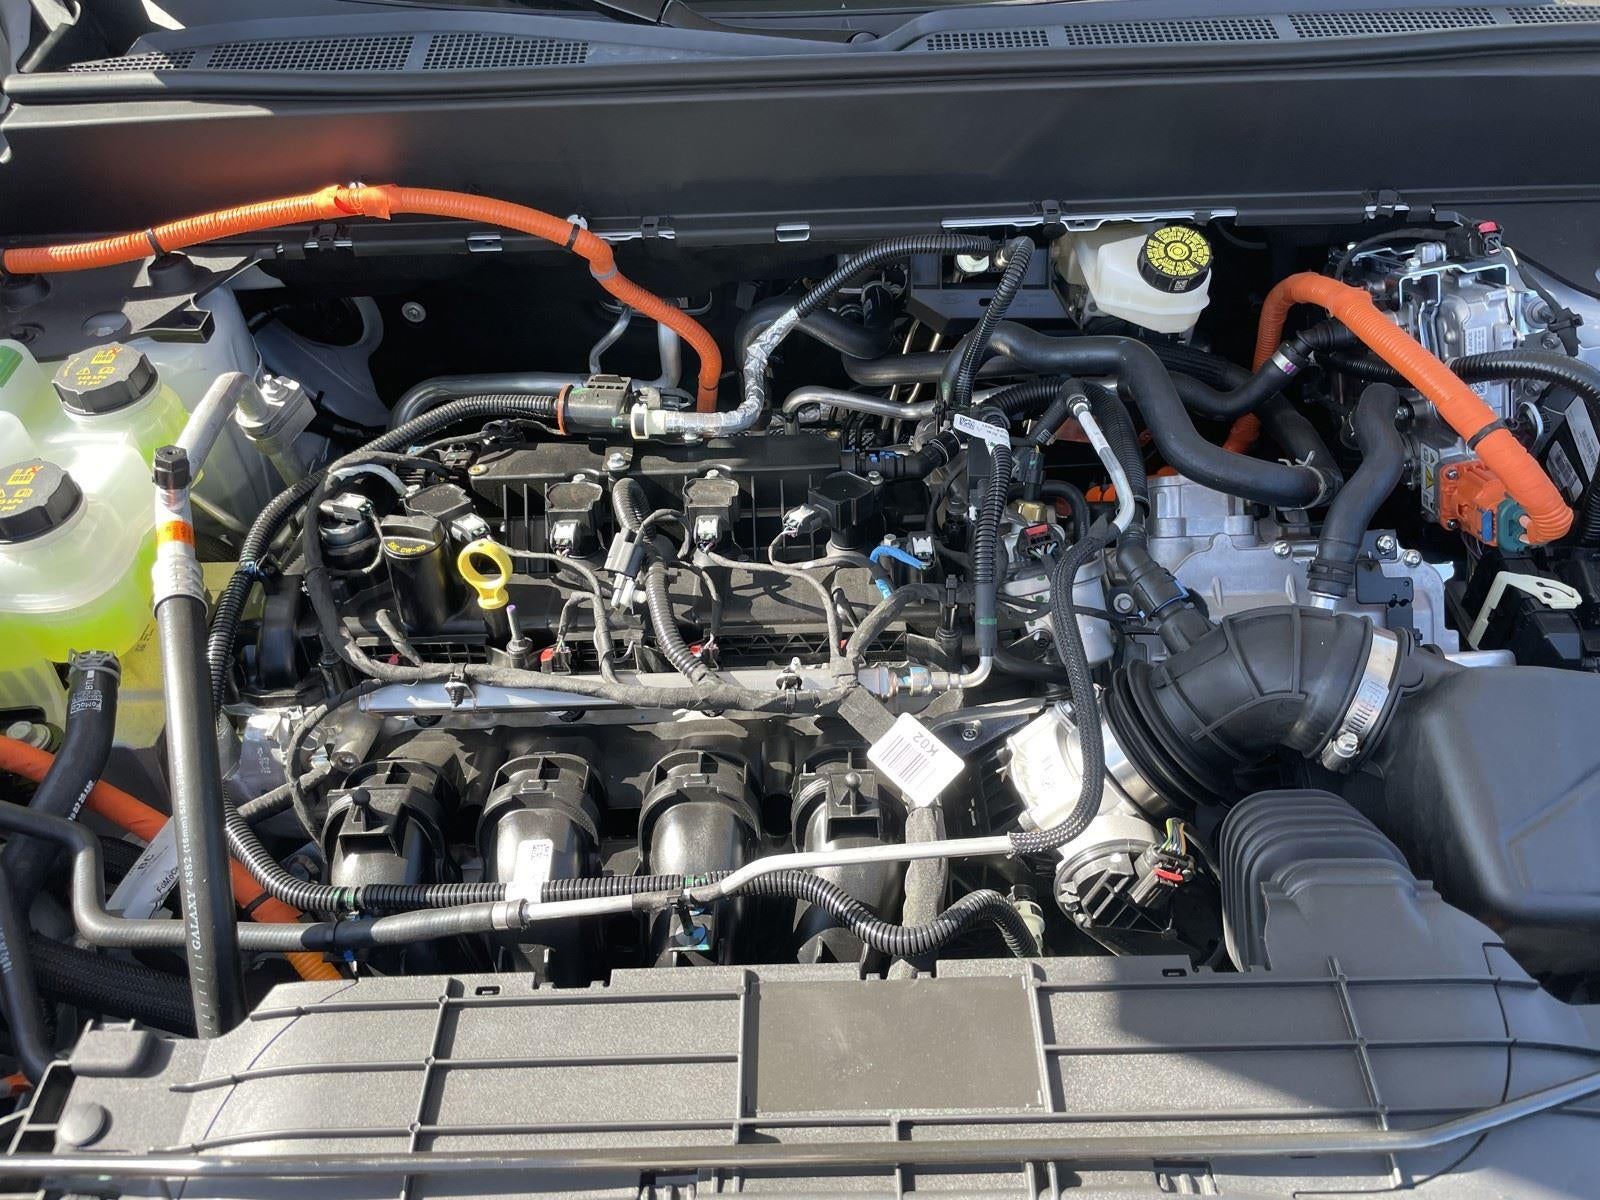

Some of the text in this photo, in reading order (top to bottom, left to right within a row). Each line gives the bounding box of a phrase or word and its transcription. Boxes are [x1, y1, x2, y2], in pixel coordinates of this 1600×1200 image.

[913, 731, 940, 757] K02
[184, 856, 194, 886] 4882
[187, 889, 201, 951] GALAXY
